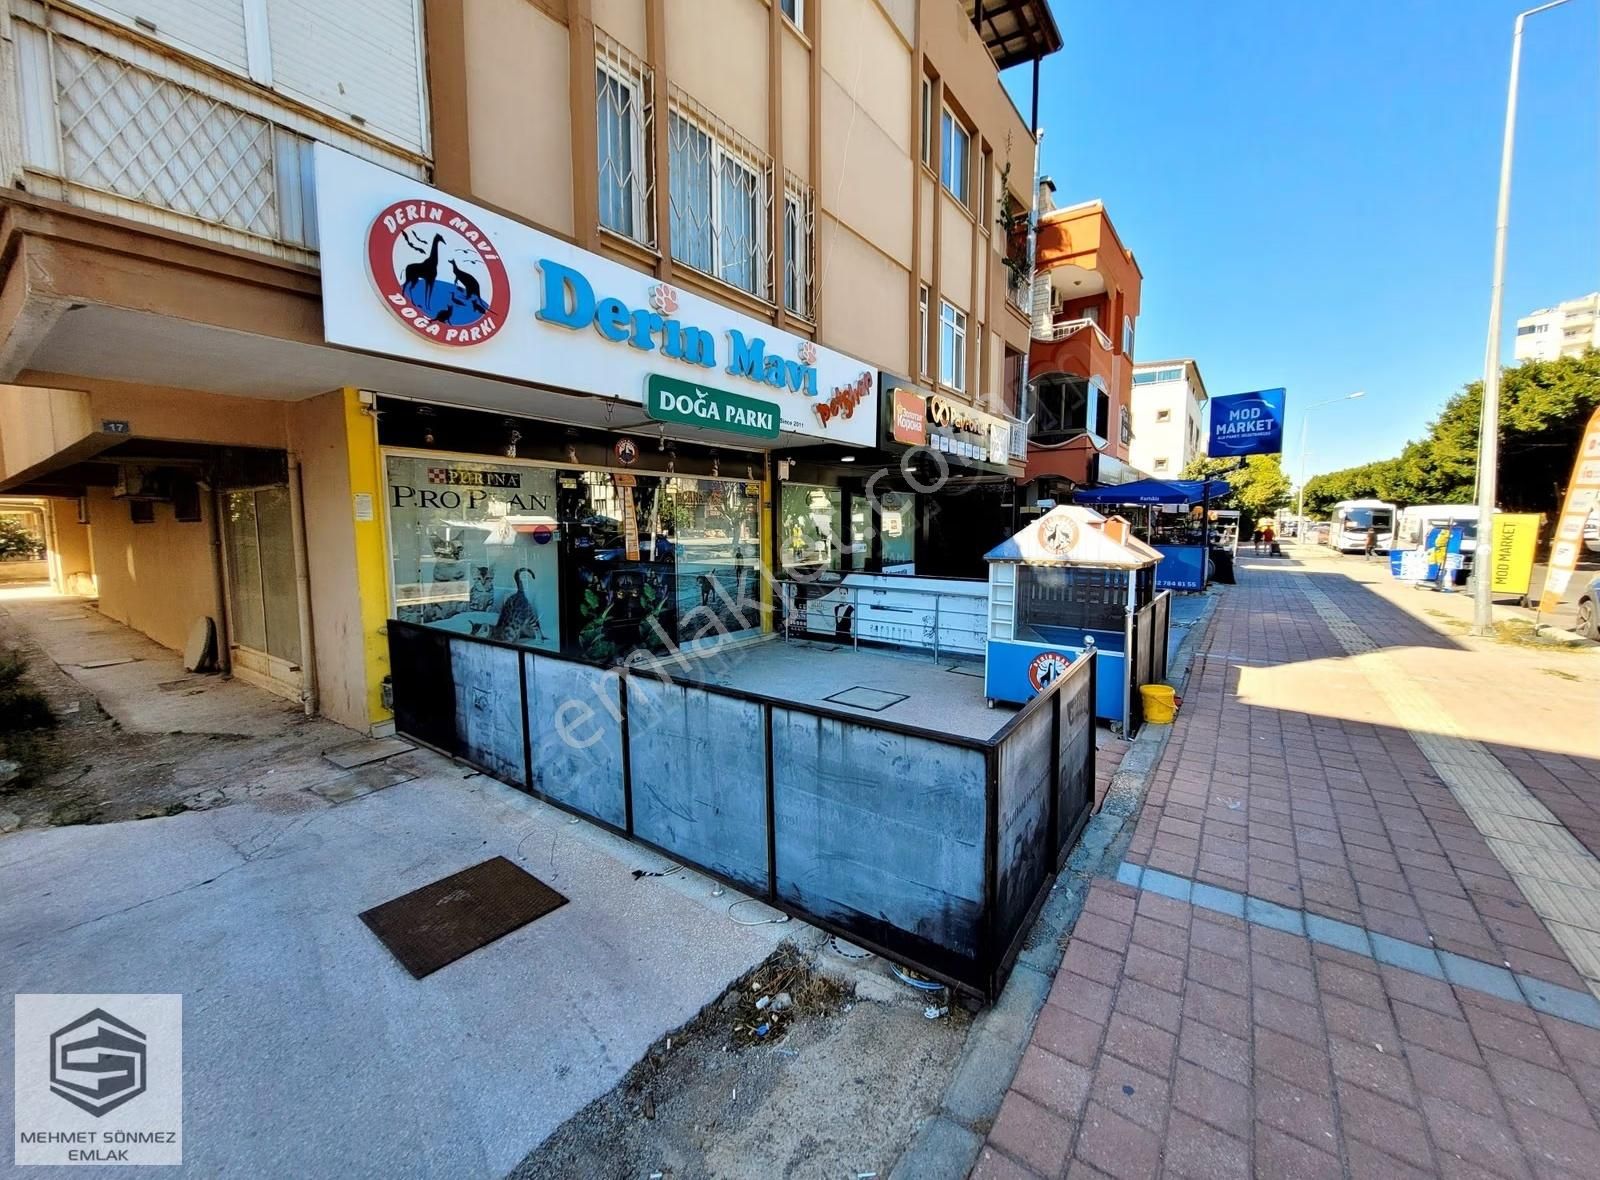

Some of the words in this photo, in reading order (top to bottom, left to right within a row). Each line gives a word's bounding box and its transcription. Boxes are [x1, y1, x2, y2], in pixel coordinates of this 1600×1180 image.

[383, 202, 442, 234] DERİN
[449, 216, 500, 261] MAVİ
[388, 292, 440, 336] DOĞA
[446, 317, 496, 343] PARKI
[535, 258, 717, 368] Derin
[726, 329, 818, 396] Mavi
[659, 387, 720, 421] DOĞA
[725, 404, 773, 430] PARKI
[1229, 408, 1261, 421] MOD
[109, 423, 124, 432] 17
[1216, 419, 1274, 435] MARKET
[449, 471, 519, 487] PURINA
[464, 489, 551, 511] PAN
[1498, 522, 1517, 562] MARKET
[1495, 564, 1510, 585] MOD
